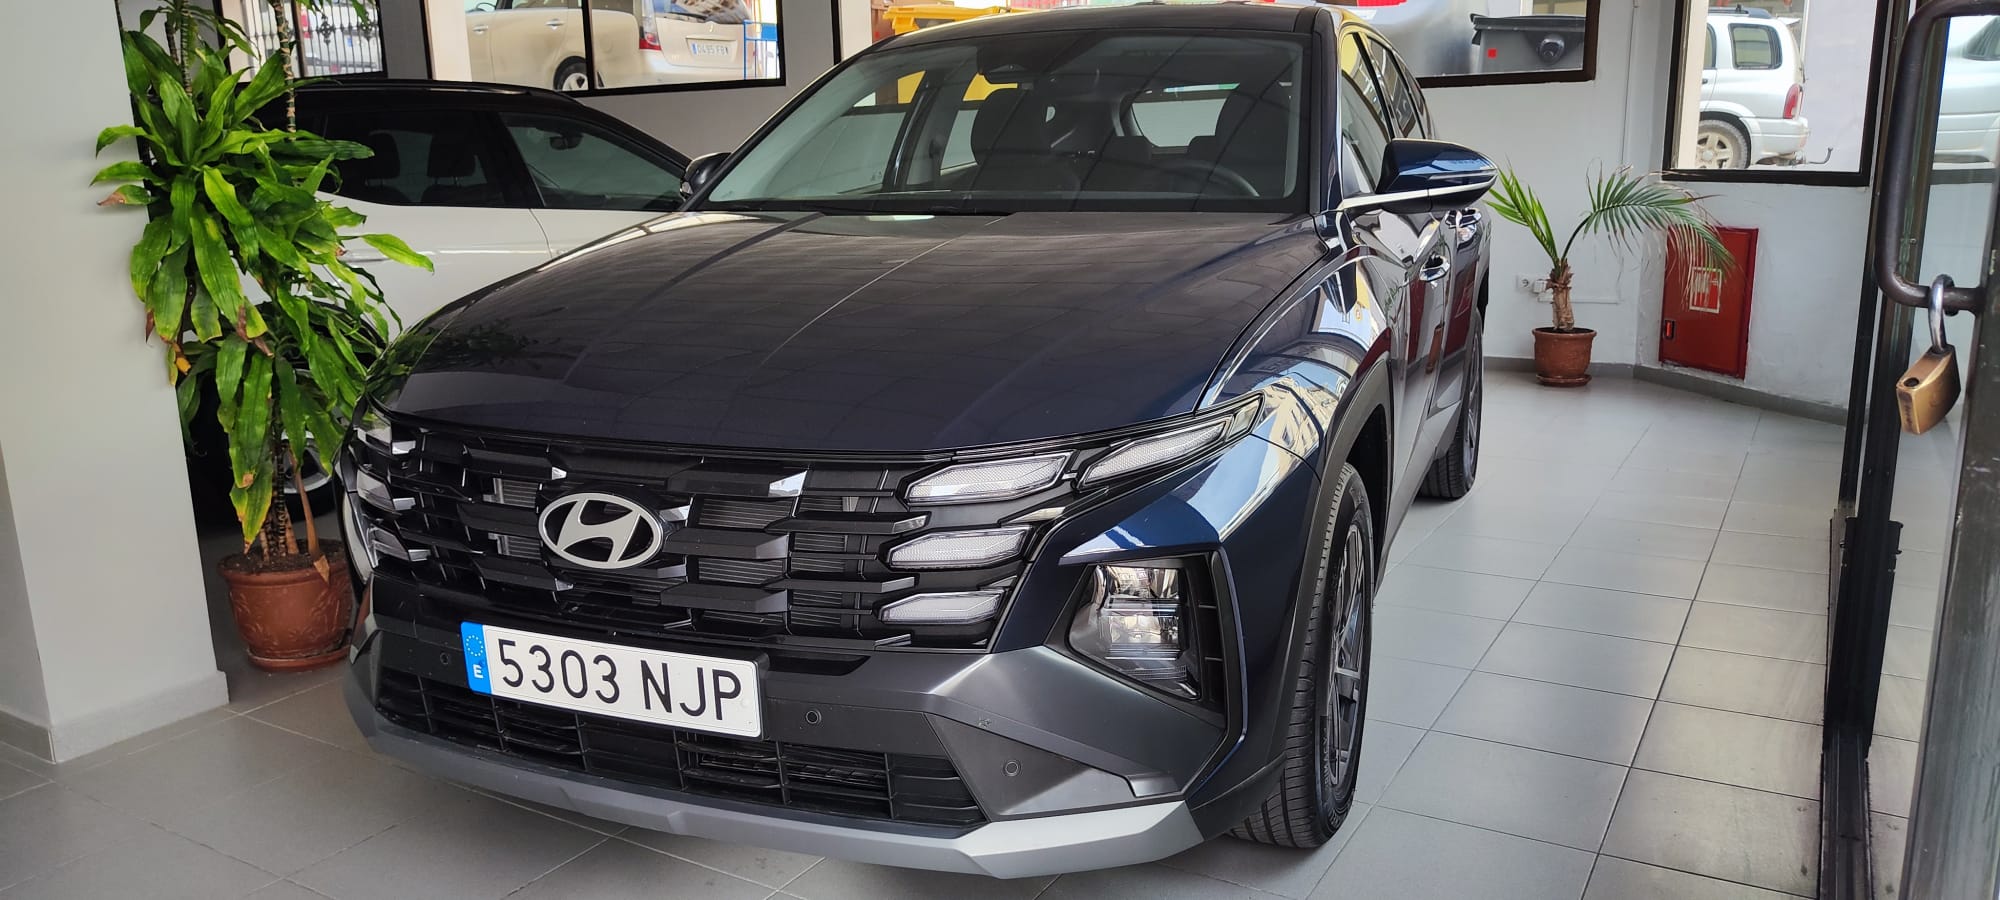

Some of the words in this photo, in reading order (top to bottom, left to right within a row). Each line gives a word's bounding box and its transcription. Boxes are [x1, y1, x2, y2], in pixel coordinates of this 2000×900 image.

[472, 663, 483, 679] E
[497, 638, 620, 704] 5303
[640, 659, 742, 721] NJP
